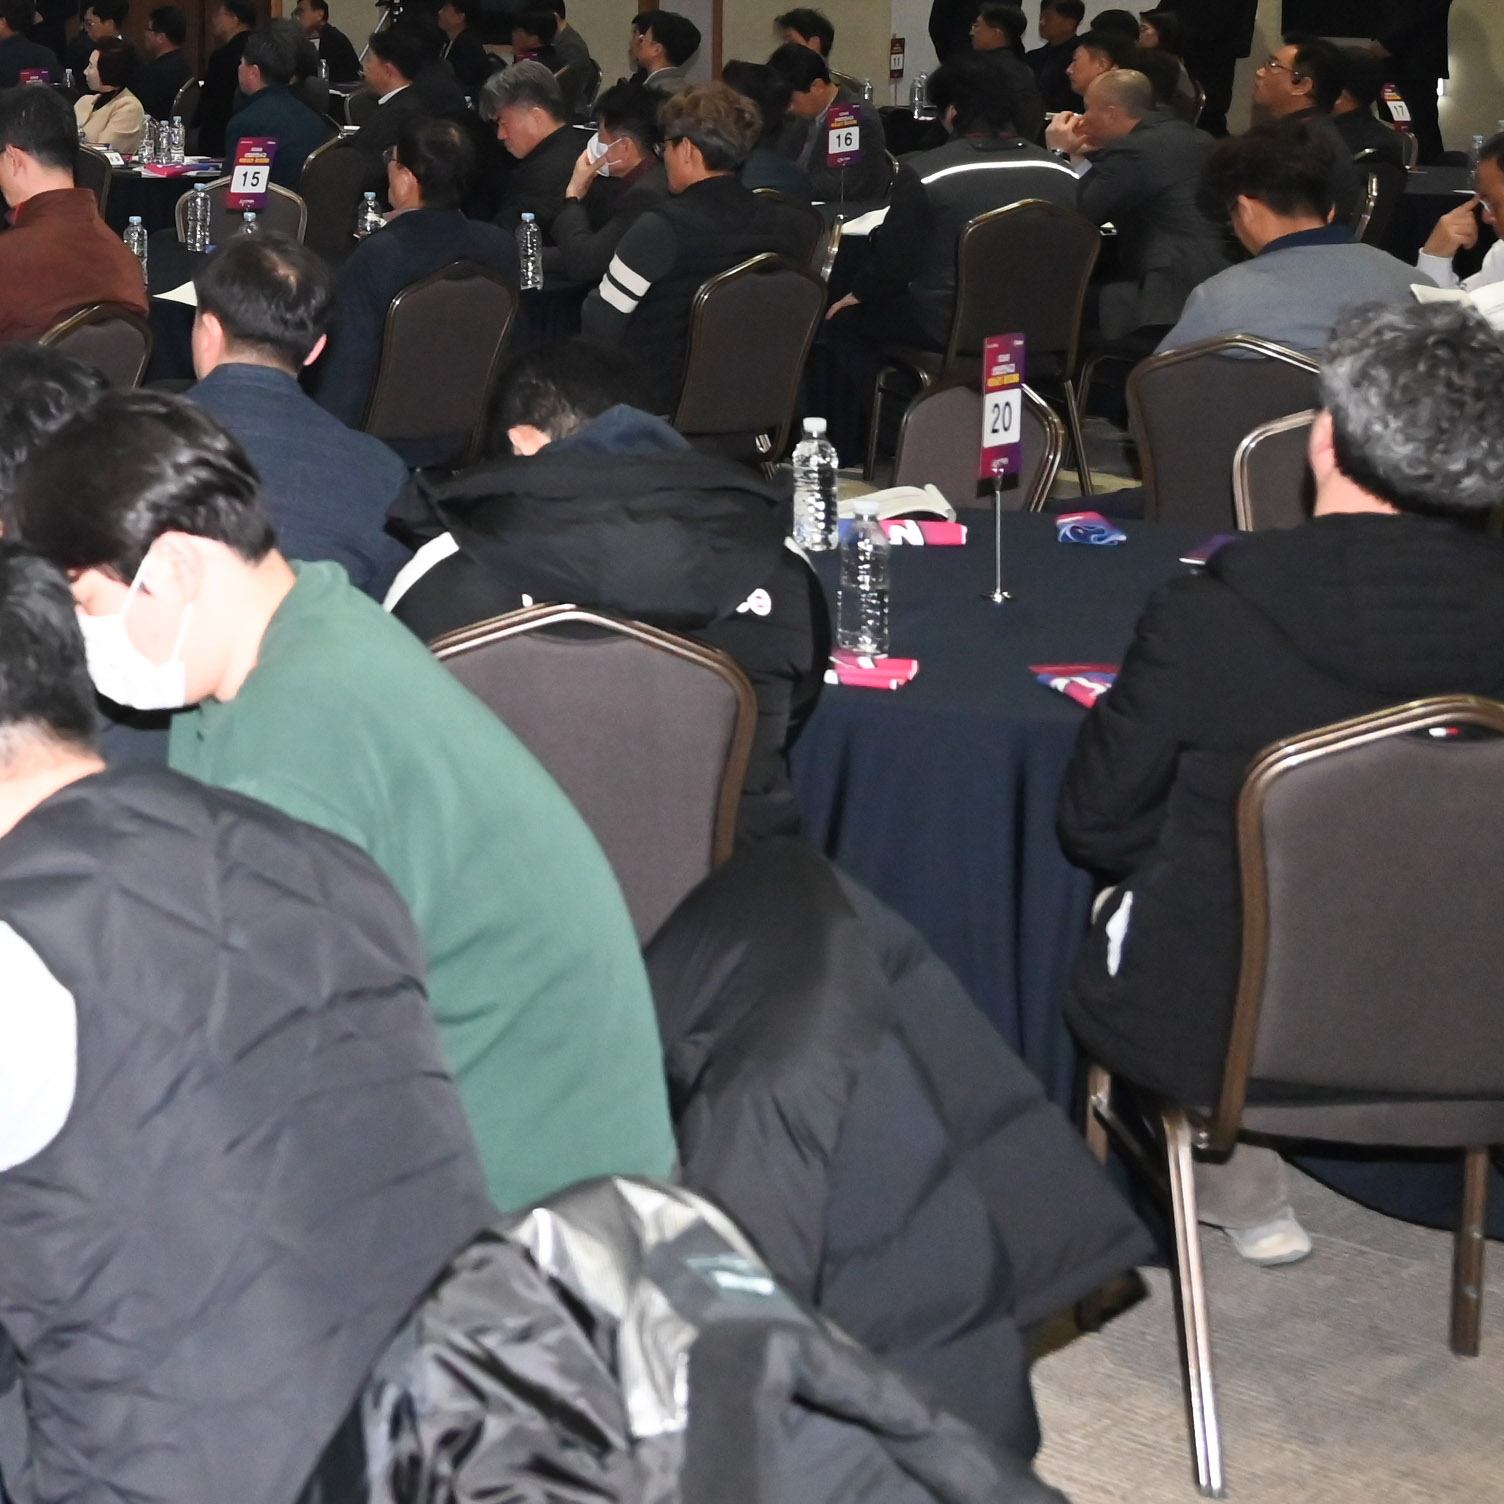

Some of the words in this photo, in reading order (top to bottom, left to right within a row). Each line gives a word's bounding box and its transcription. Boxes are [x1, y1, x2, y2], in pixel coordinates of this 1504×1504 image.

[835, 132, 853, 148] 16
[241, 171, 260, 187] 15
[990, 401, 1012, 434] 20
